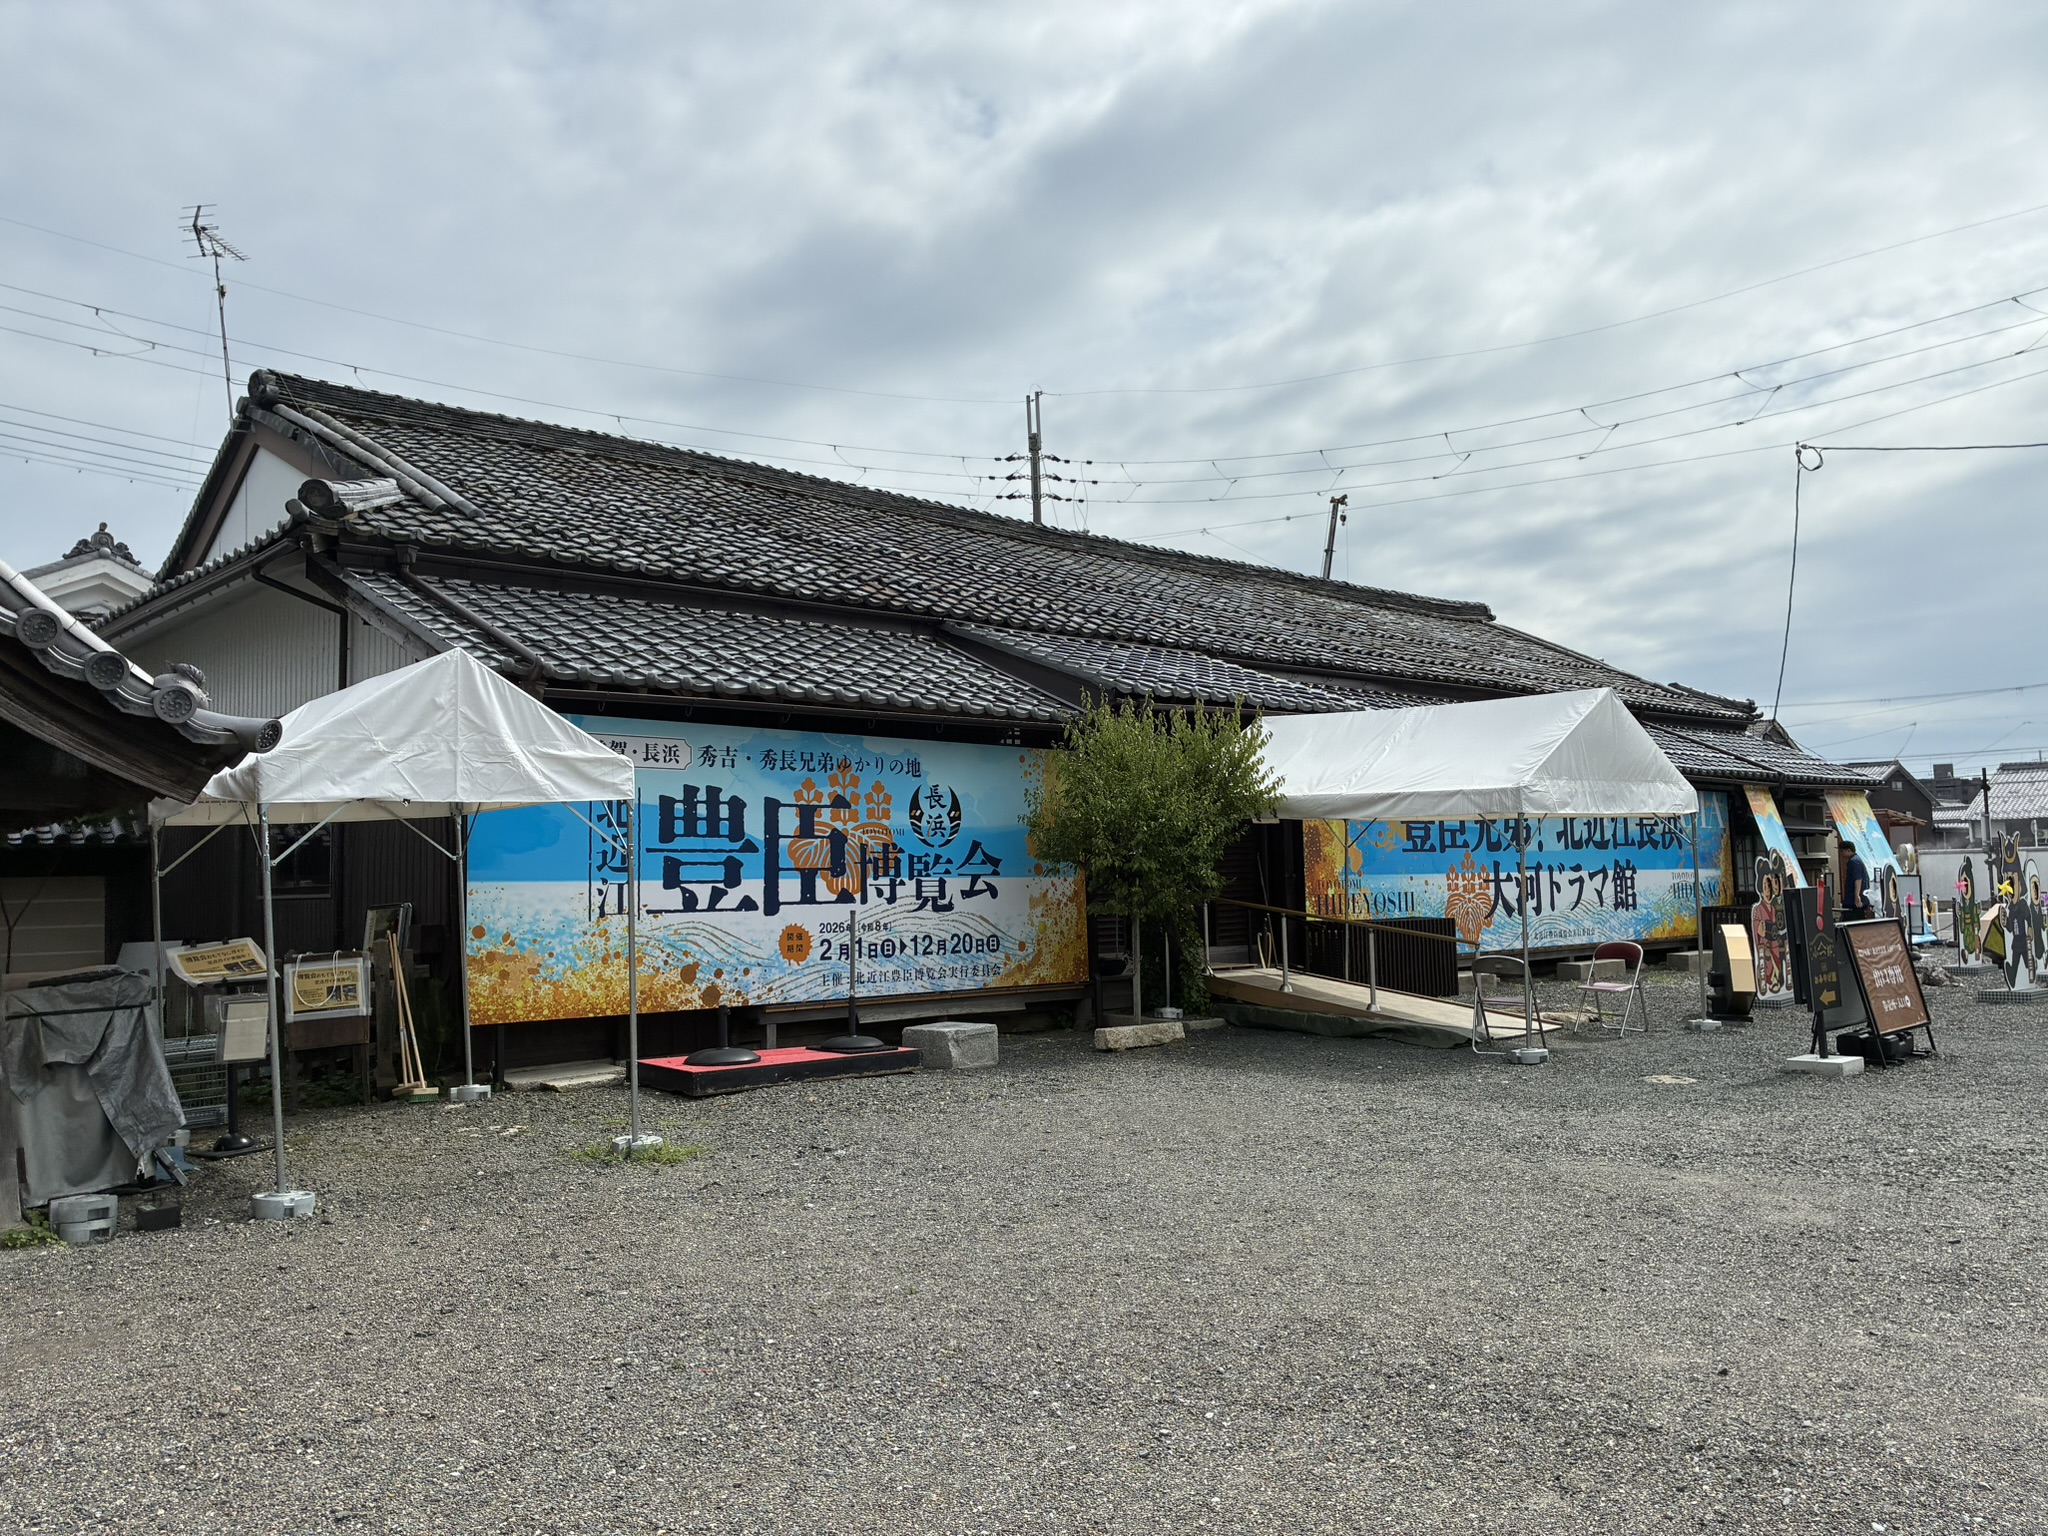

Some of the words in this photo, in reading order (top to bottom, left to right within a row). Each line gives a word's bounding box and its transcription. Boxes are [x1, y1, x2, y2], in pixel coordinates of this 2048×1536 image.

[599, 739, 680, 764] 賀・長浜
[697, 744, 922, 778] 秀吉・秀長兄弟ゆかりの地
[924, 784, 947, 838] 長浜
[1483, 858, 1638, 920] 大河ドラマ館
